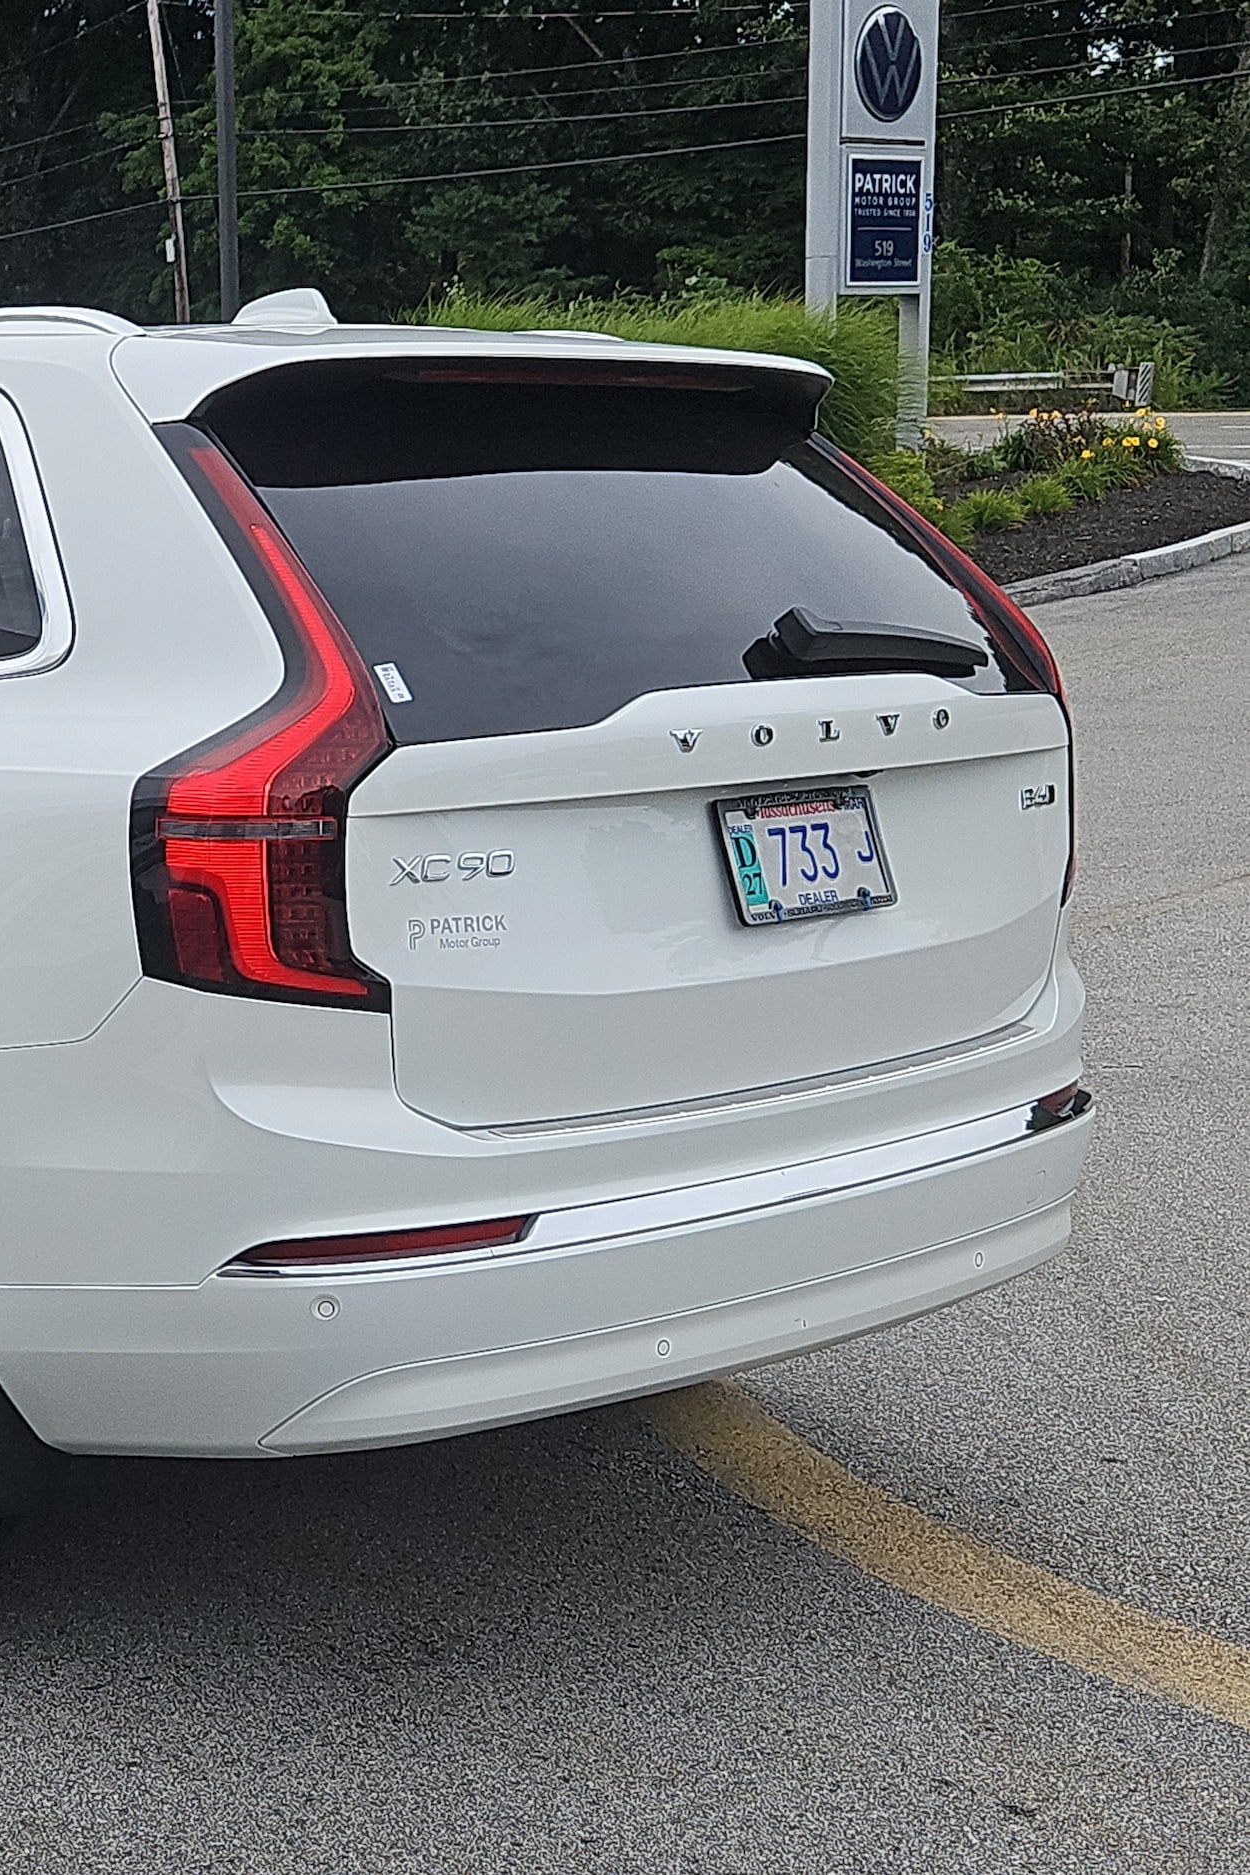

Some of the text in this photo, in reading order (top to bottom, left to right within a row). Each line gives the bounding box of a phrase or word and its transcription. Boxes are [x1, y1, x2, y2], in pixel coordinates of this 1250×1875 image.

[854, 173, 916, 194] PATRICK
[854, 196, 916, 207] MOTOR GROUP
[854, 208, 881, 216] TRUSTED
[883, 208, 901, 217] SINCE
[924, 193, 933, 252] 519
[874, 240, 894, 256] 519
[854, 258, 912, 270] Washington Street
[670, 708, 950, 753] VOLVO
[758, 800, 836, 819] assachusetts
[731, 836, 757, 868] D
[767, 822, 874, 887] 733 J
[742, 872, 763, 895] 27
[798, 889, 839, 906] DEALER
[430, 914, 507, 935] PATRICK
[750, 911, 778, 921] VOLV
[439, 936, 501, 950] Motor Group
